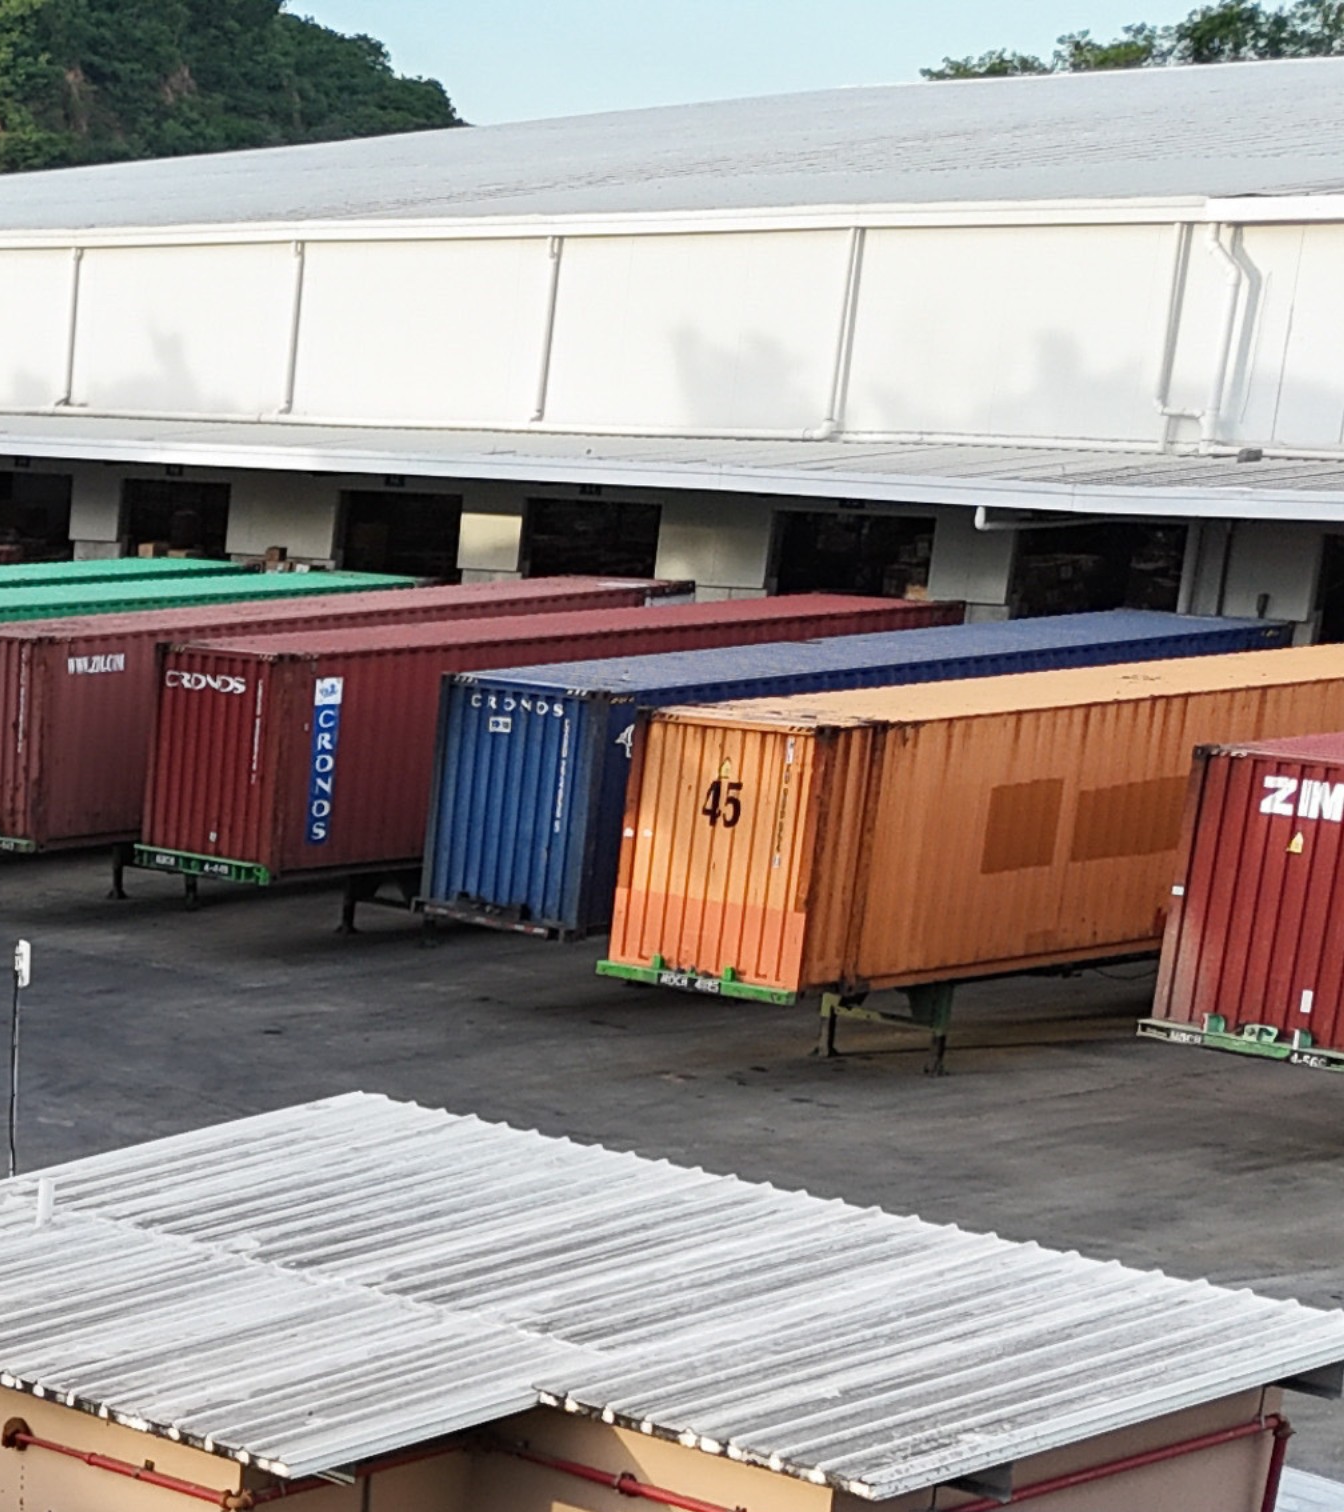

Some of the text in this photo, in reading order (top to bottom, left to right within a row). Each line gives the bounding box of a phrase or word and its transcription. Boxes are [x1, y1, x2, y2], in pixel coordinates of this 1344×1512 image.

[166, 670, 246, 694] CRONOS
[471, 694, 564, 717] CRONOS
[311, 709, 334, 840] CRONOS
[701, 780, 743, 828] 45
[1259, 775, 1344, 822] ZIM
